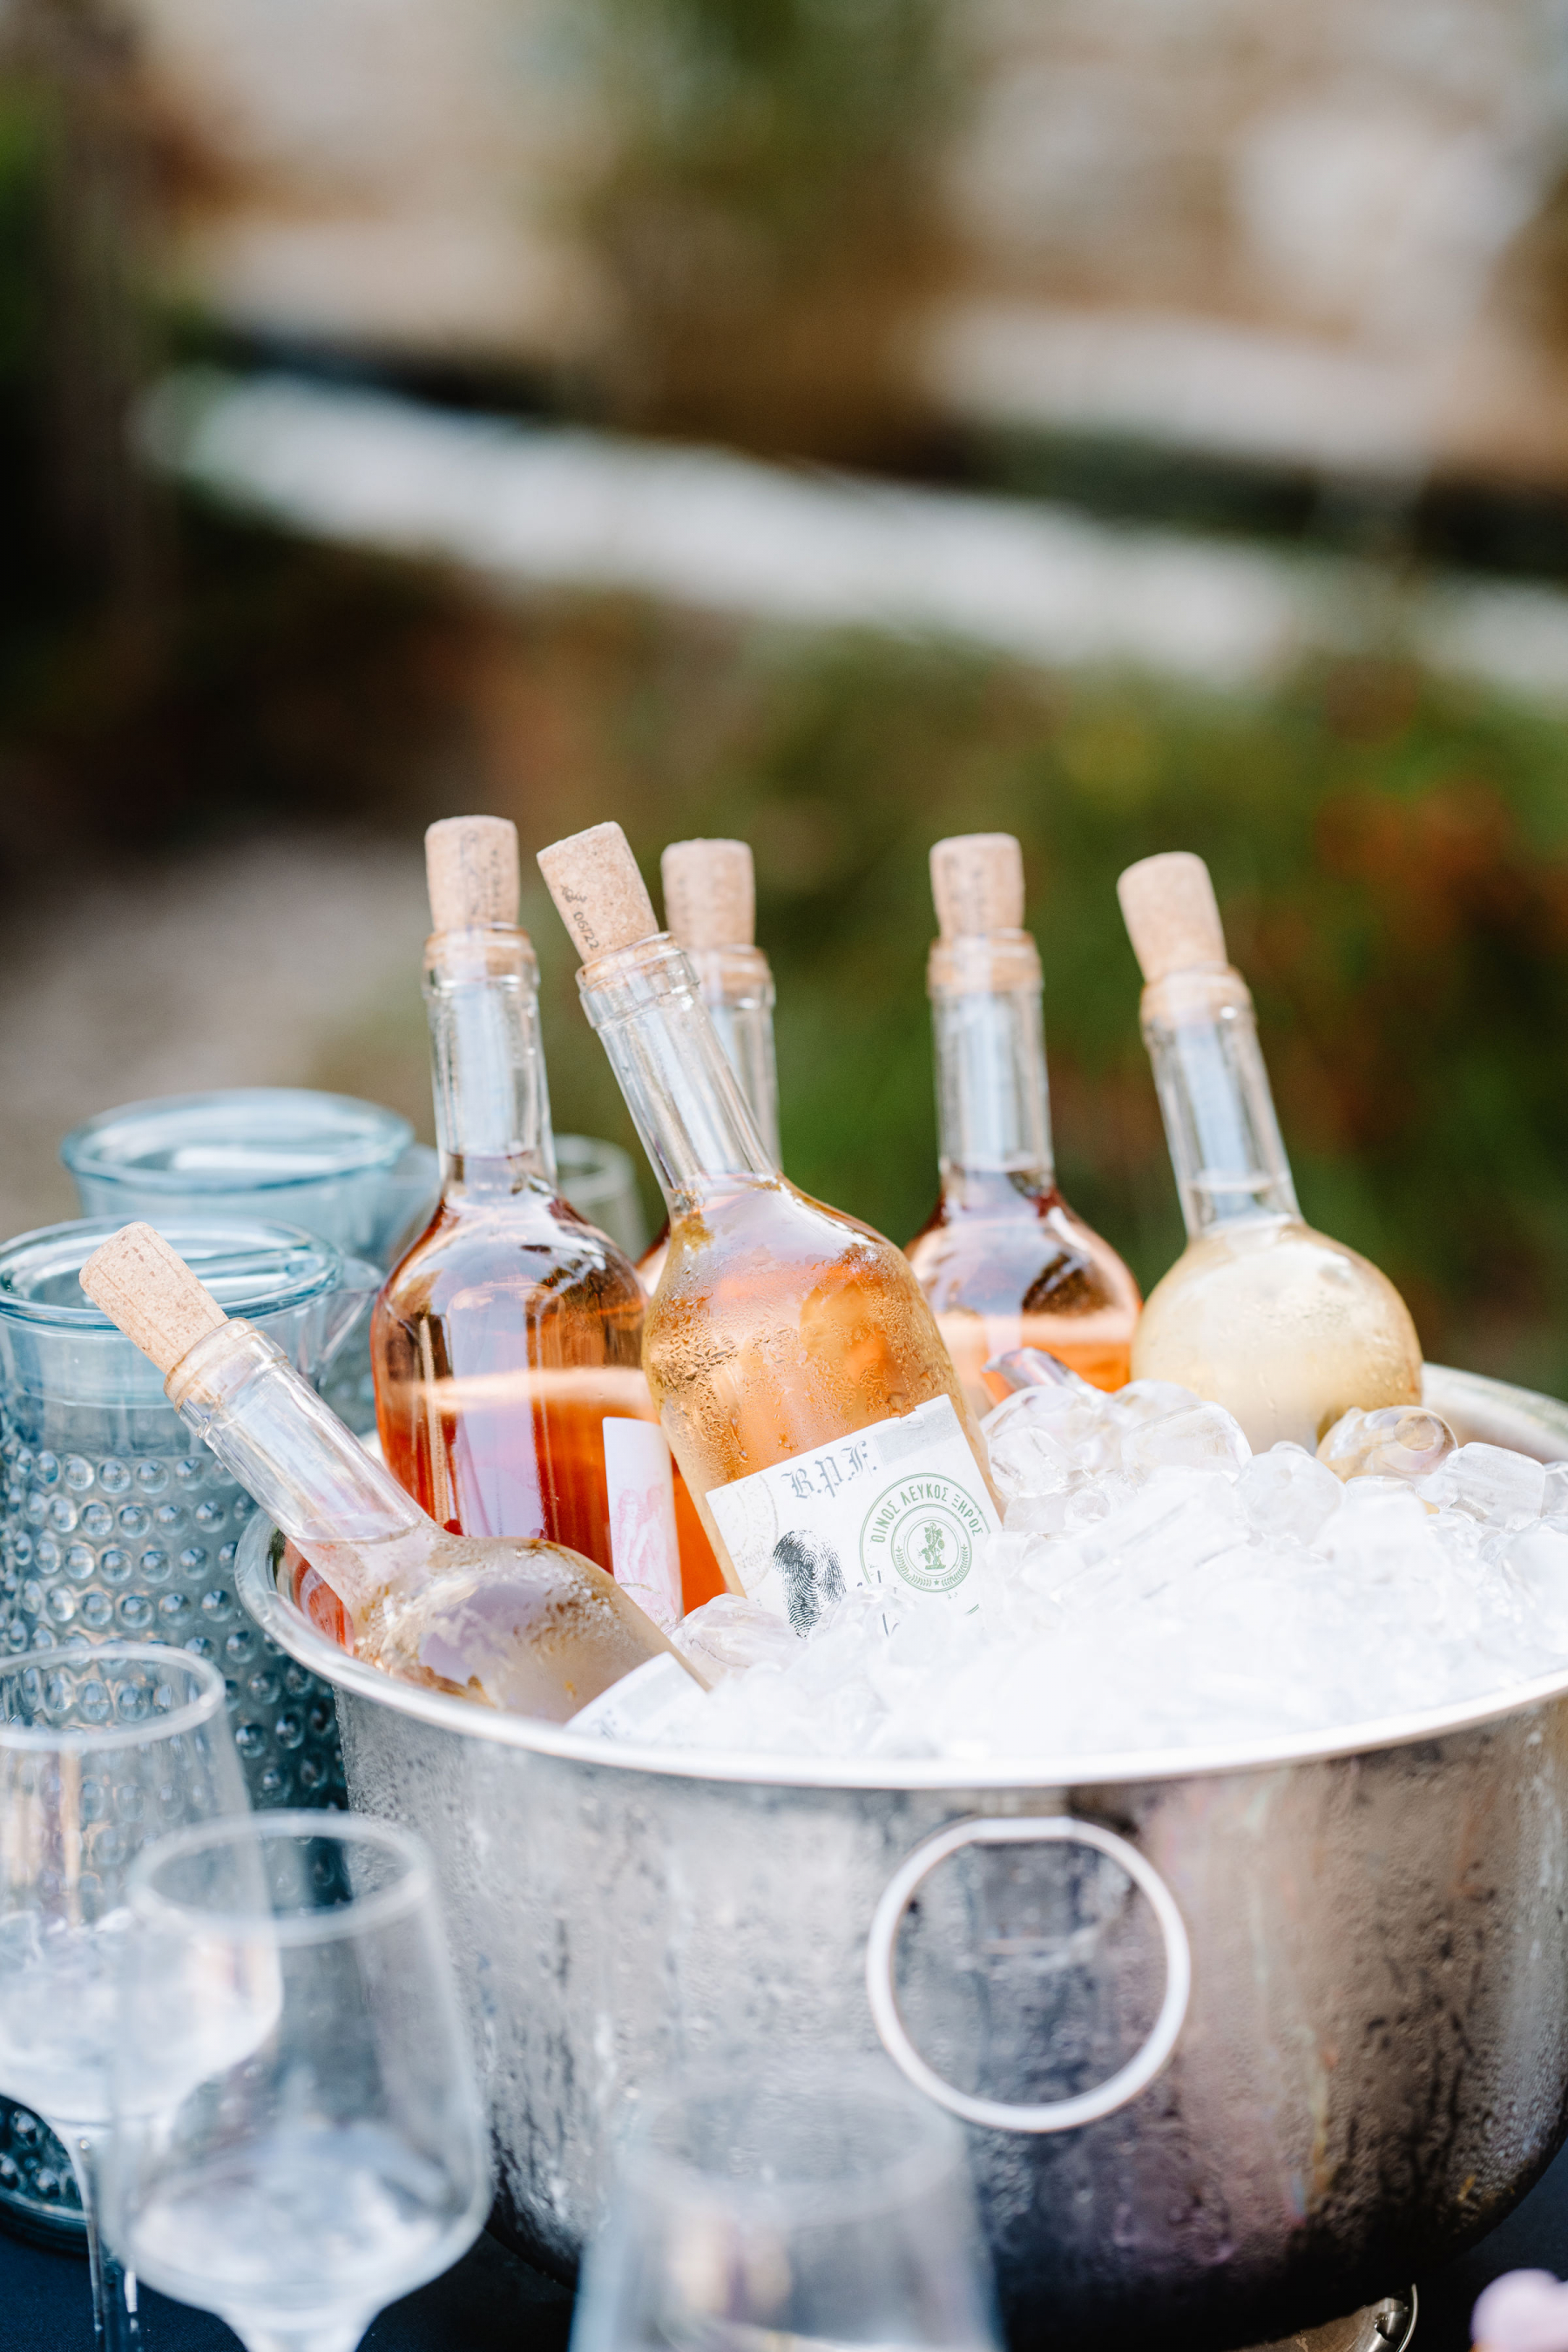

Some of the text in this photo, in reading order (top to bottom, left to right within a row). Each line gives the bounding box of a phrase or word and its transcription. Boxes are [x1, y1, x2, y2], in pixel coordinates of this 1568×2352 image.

[573, 911, 599, 951] 06/22
[871, 1483, 983, 1543] ΟΙΝΟΣ ΛΕΥΚΟΣ ΞΗΡΟΣ
